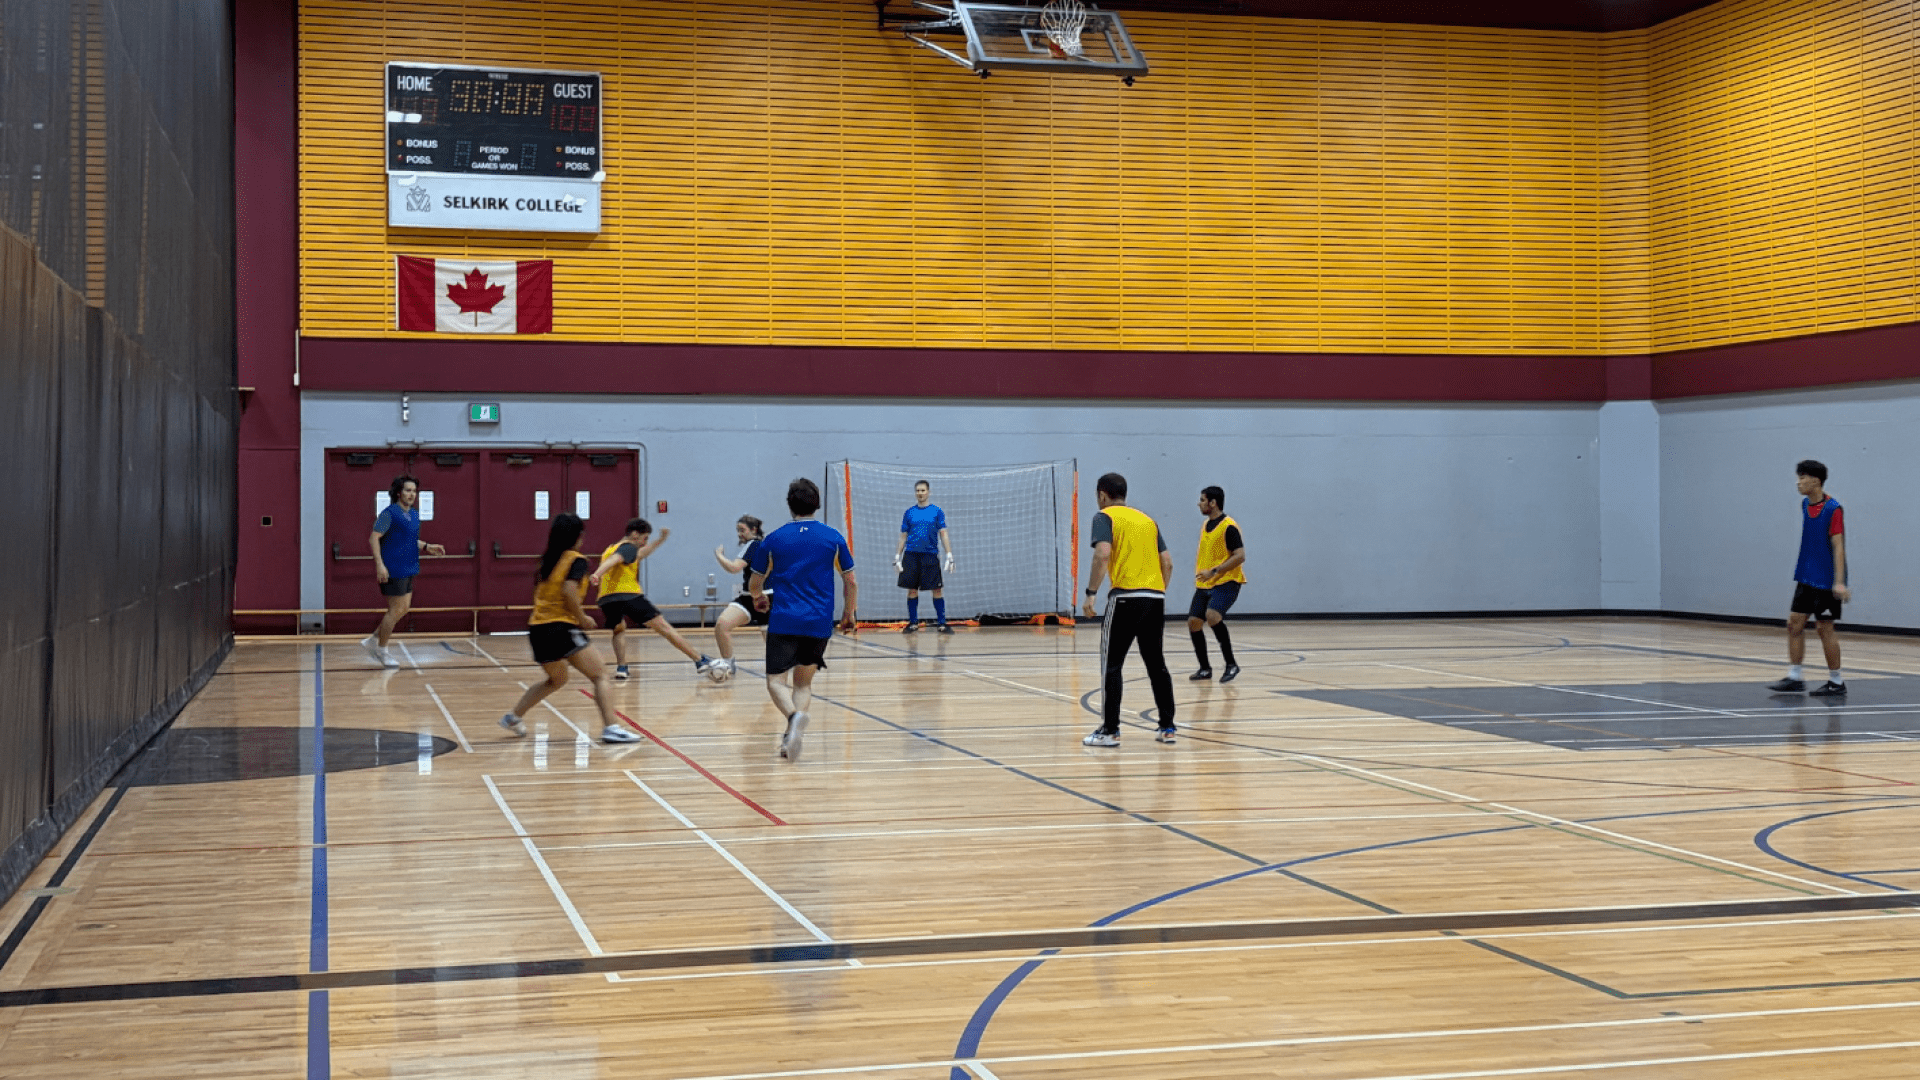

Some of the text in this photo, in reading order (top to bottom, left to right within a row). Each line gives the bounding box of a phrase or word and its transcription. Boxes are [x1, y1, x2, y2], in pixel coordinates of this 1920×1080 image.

[397, 75, 433, 92] HOME
[553, 83, 593, 99] GUEST
[406, 139, 438, 149] BONUS
[480, 146, 509, 154] PERIOD
[565, 145, 596, 155] BONUS
[406, 155, 433, 164] POSS.
[471, 161, 519, 171] GAMES WON
[565, 162, 591, 171] POSS.
[443, 195, 583, 213] SELKIRK COLLEGE
